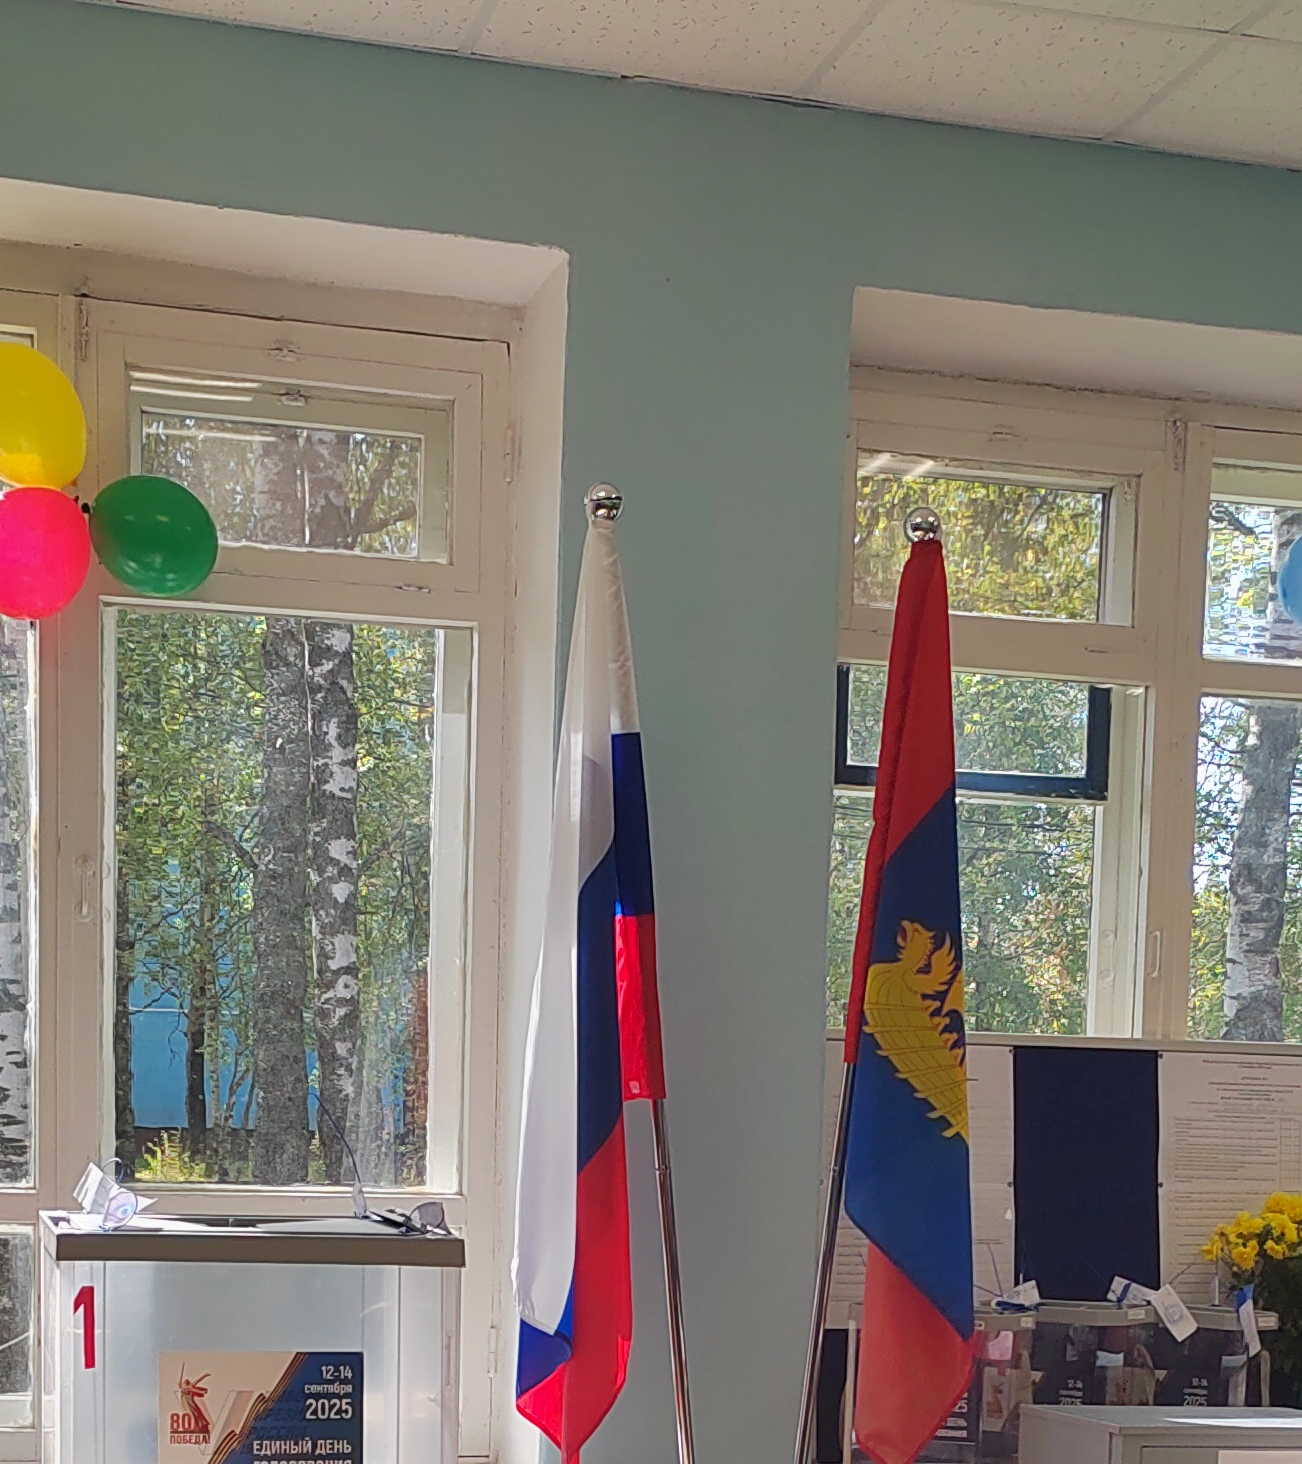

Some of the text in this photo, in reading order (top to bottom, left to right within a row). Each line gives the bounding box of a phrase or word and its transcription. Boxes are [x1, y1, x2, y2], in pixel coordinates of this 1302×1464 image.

[73, 1285, 96, 1369] 1
[320, 1365, 353, 1380] 12-14
[304, 1382, 353, 1396] сентября
[305, 1398, 353, 1420] 2025
[170, 1412, 192, 1431] 80
[169, 1433, 211, 1445] ПОБЕДА!
[252, 1437, 352, 1457] ЕДИНЫЙ ДЕНЬ
